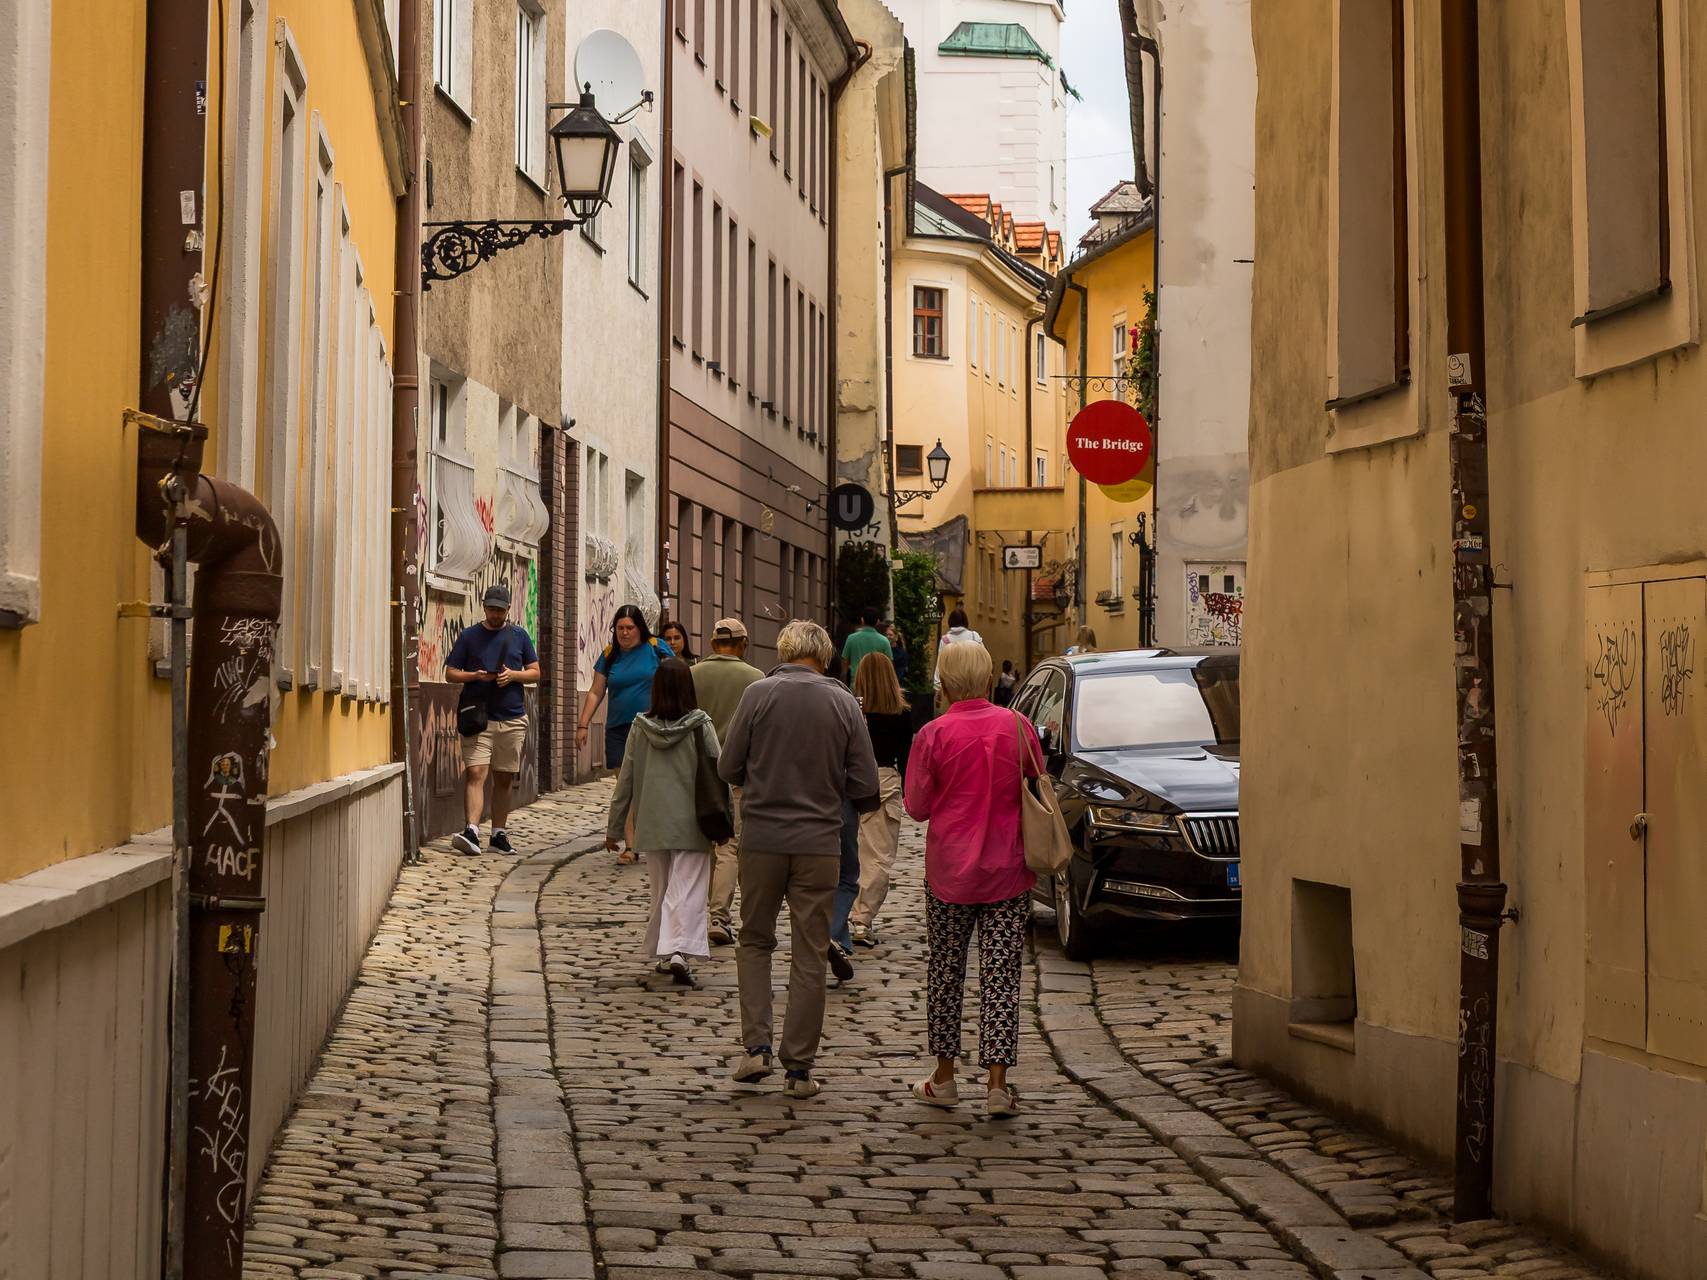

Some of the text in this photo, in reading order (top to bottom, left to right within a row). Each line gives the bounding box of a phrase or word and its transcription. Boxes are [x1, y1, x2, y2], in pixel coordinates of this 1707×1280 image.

[1075, 437, 1144, 453] The Bridge
[839, 494, 862, 522] U
